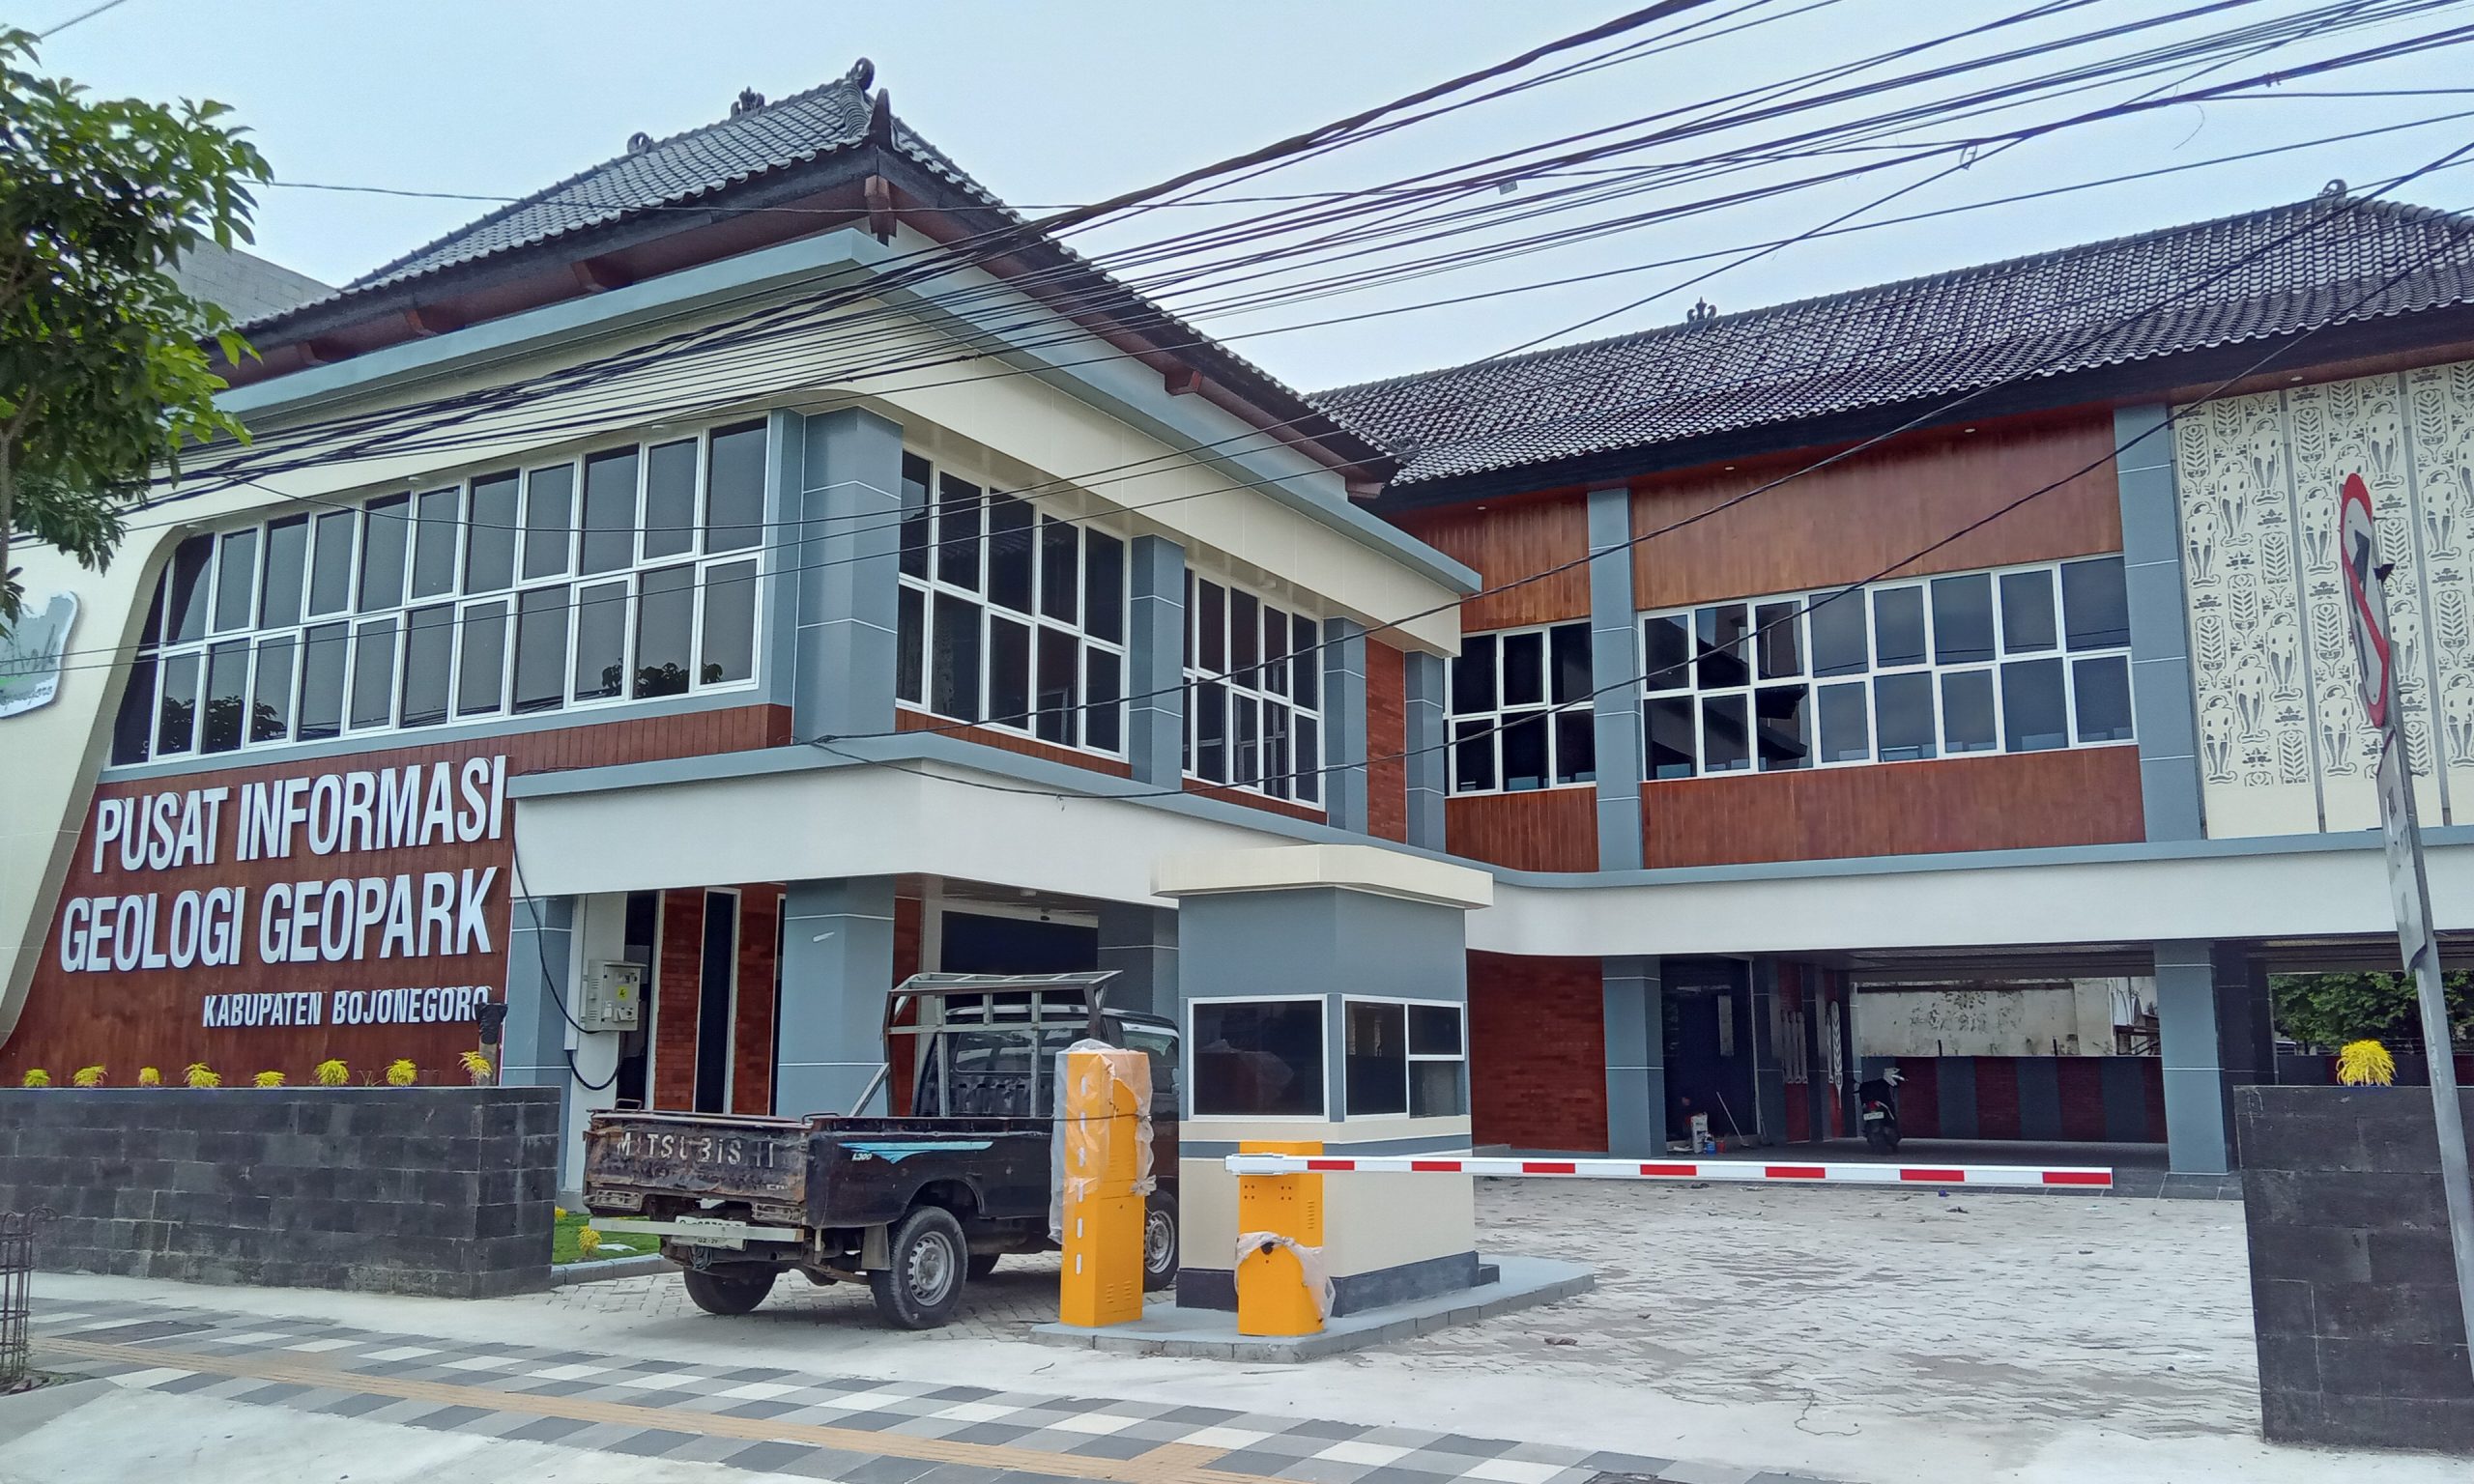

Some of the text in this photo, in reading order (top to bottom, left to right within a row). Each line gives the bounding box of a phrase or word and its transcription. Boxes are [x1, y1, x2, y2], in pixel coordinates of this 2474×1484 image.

[94, 756, 507, 873] PUSAT INFORMASI
[61, 867, 498, 972] GEOLOGI GEOPARK
[203, 986, 490, 1028] KABUPATEN BOJONEGORO
